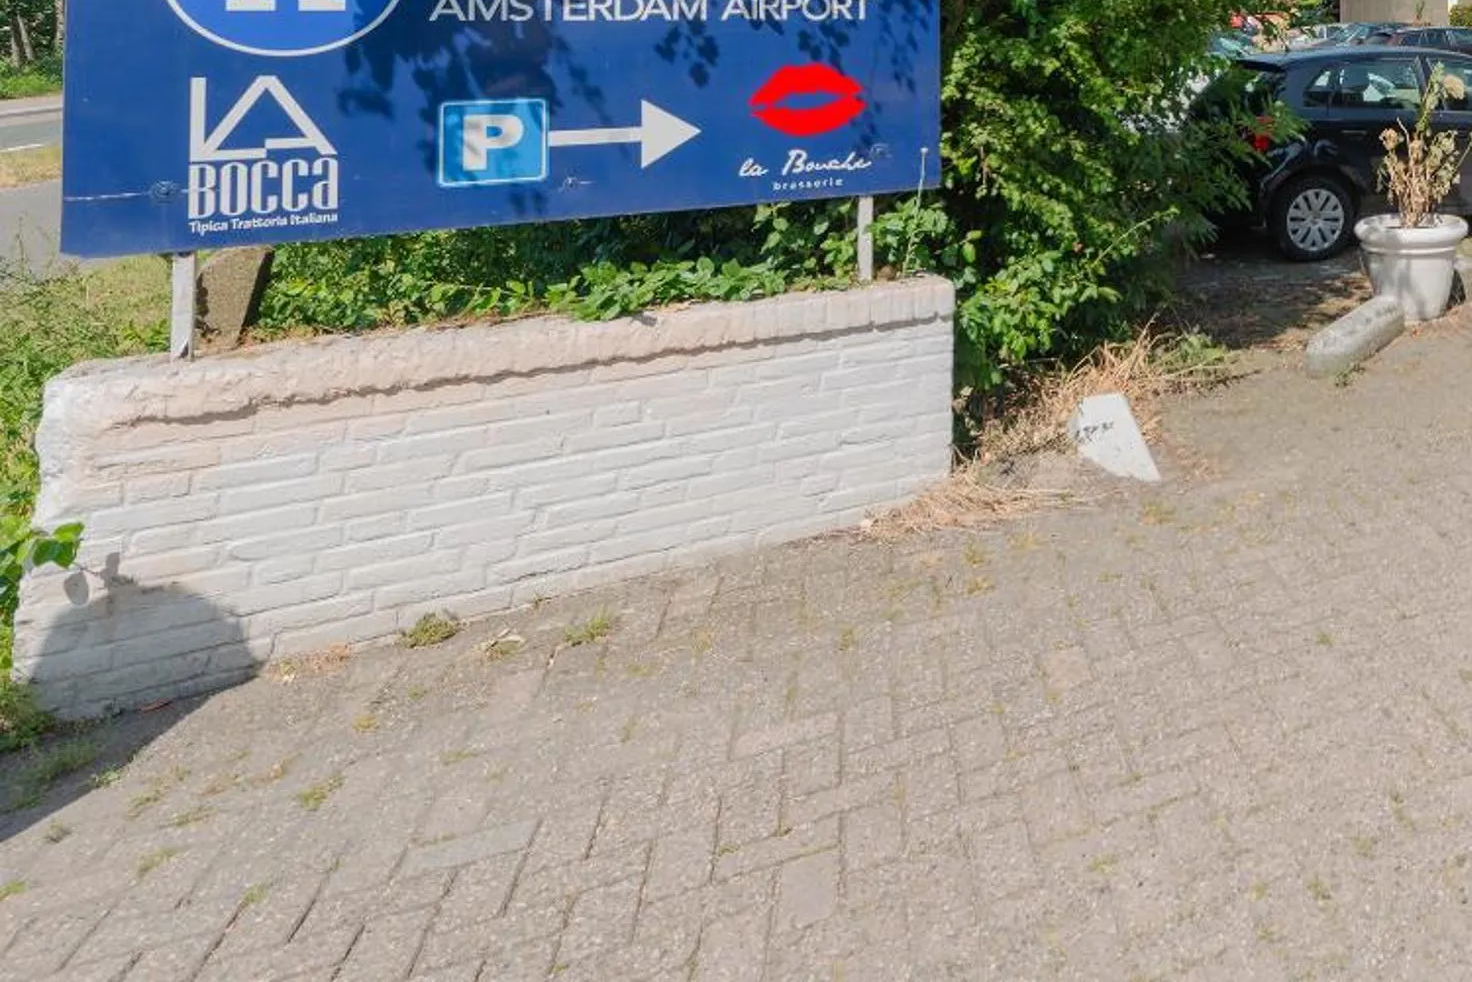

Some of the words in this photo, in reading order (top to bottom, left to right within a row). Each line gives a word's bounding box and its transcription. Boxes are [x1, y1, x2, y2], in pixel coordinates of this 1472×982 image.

[190, 75, 338, 162] LA
[462, 114, 524, 171] P
[738, 157, 769, 177] la
[773, 177, 845, 191] brasserie
[188, 219, 228, 236] Tipica
[231, 216, 288, 230] Trattoria
[290, 212, 338, 226] Italiana
